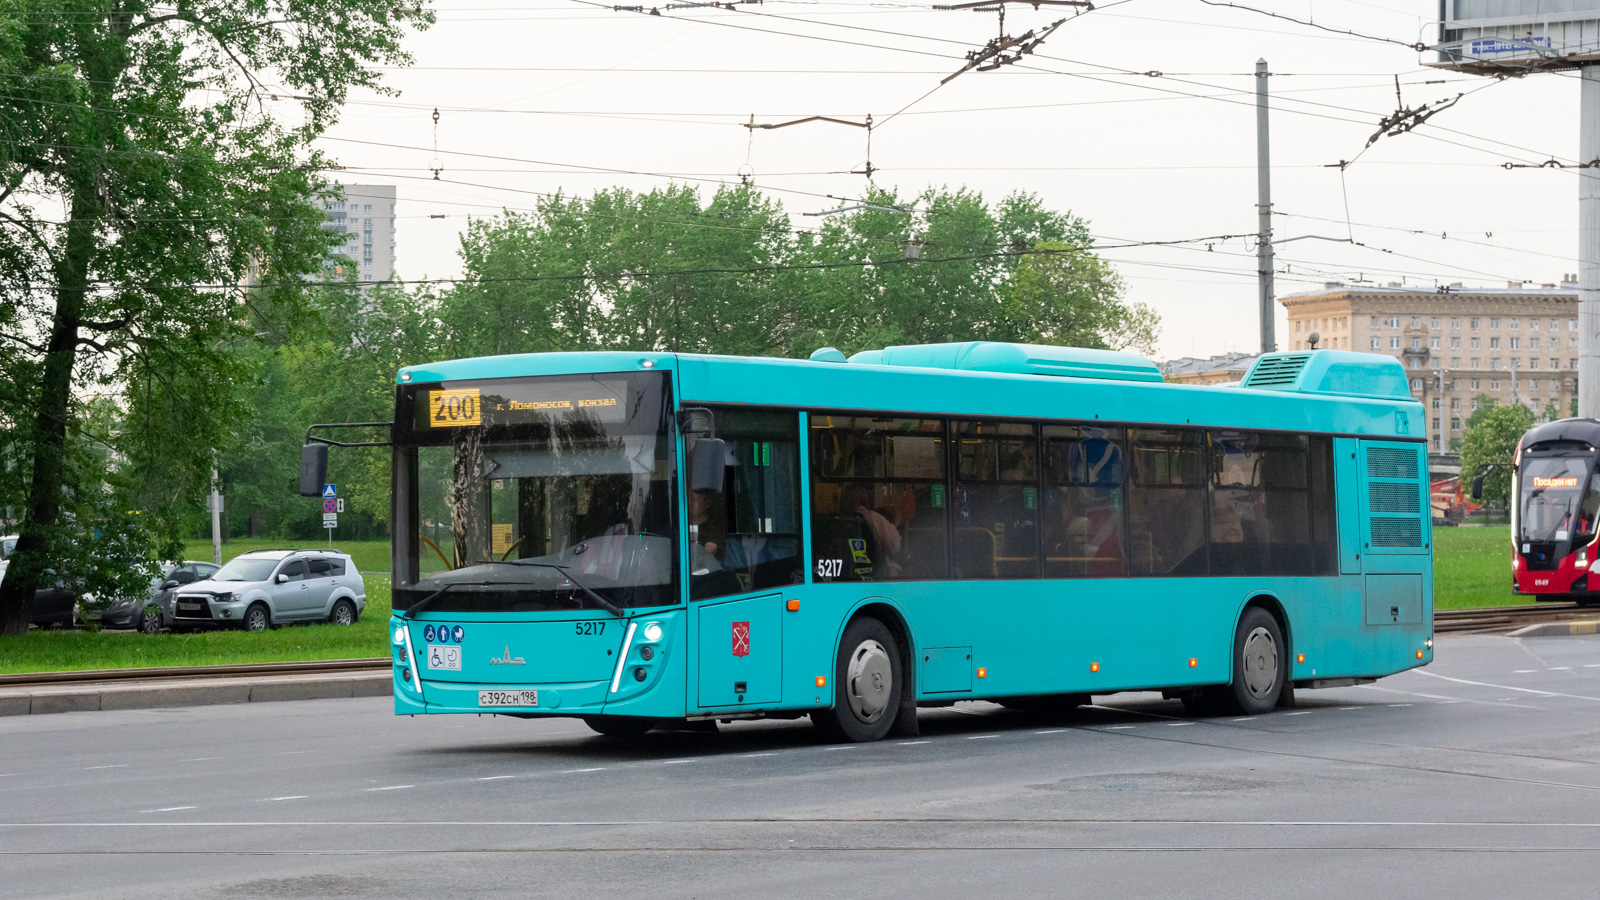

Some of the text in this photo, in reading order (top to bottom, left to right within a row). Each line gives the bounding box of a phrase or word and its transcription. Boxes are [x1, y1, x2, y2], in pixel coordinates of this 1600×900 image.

[434, 395, 474, 421] 200
[497, 398, 617, 411] г. Ломоносов, вокзал
[1533, 477, 1578, 488] Посадки нет
[817, 559, 843, 577] 5217
[575, 622, 606, 636] 5217
